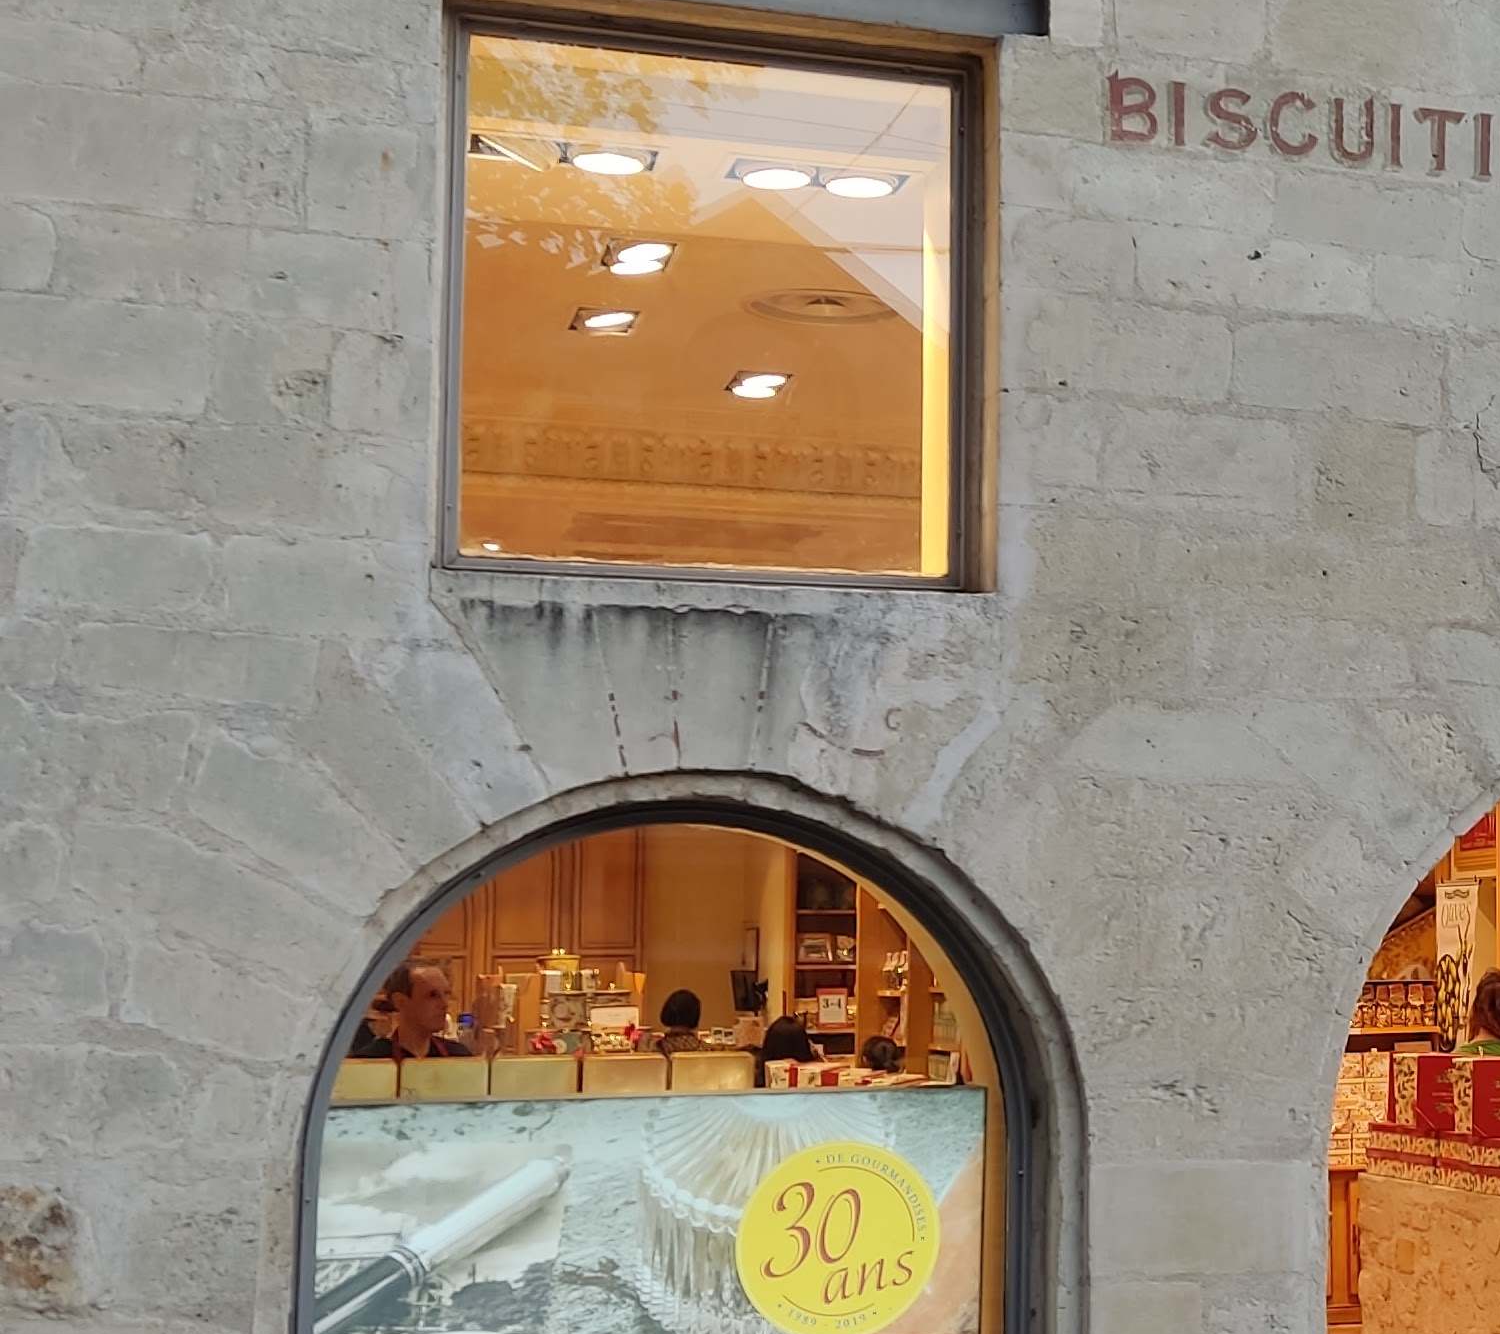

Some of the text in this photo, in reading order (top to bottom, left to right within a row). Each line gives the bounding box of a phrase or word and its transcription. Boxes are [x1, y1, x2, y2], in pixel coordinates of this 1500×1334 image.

[826, 1154, 845, 1165] DE
[760, 1181, 861, 1280] 30
[823, 1250, 914, 1305] ans
